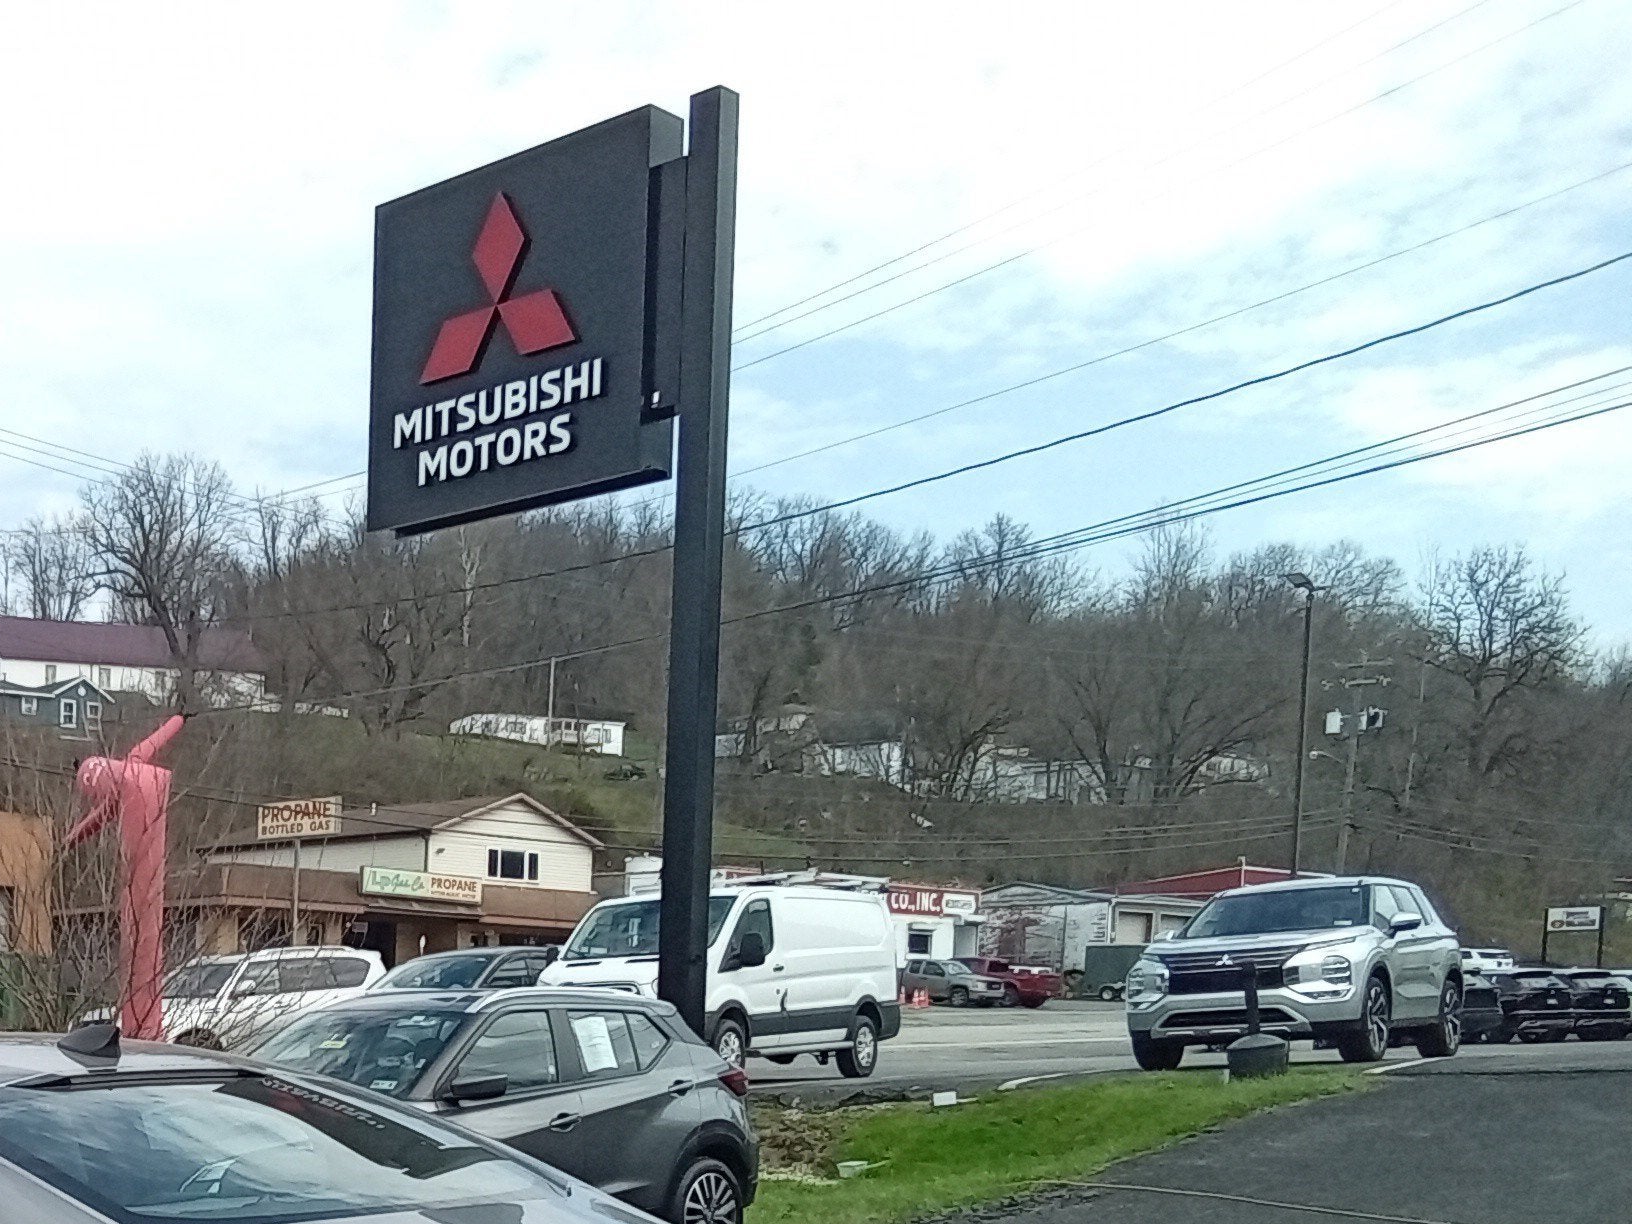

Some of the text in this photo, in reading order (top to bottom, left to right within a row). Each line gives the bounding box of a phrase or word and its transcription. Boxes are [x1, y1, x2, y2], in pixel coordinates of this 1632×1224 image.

[393, 357, 604, 449] MITSUBISHI
[417, 413, 572, 487] MOTORS
[261, 800, 331, 824] PROPANE
[261, 819, 331, 836] BOTTLED GAS
[430, 877, 477, 892] PROPANE
